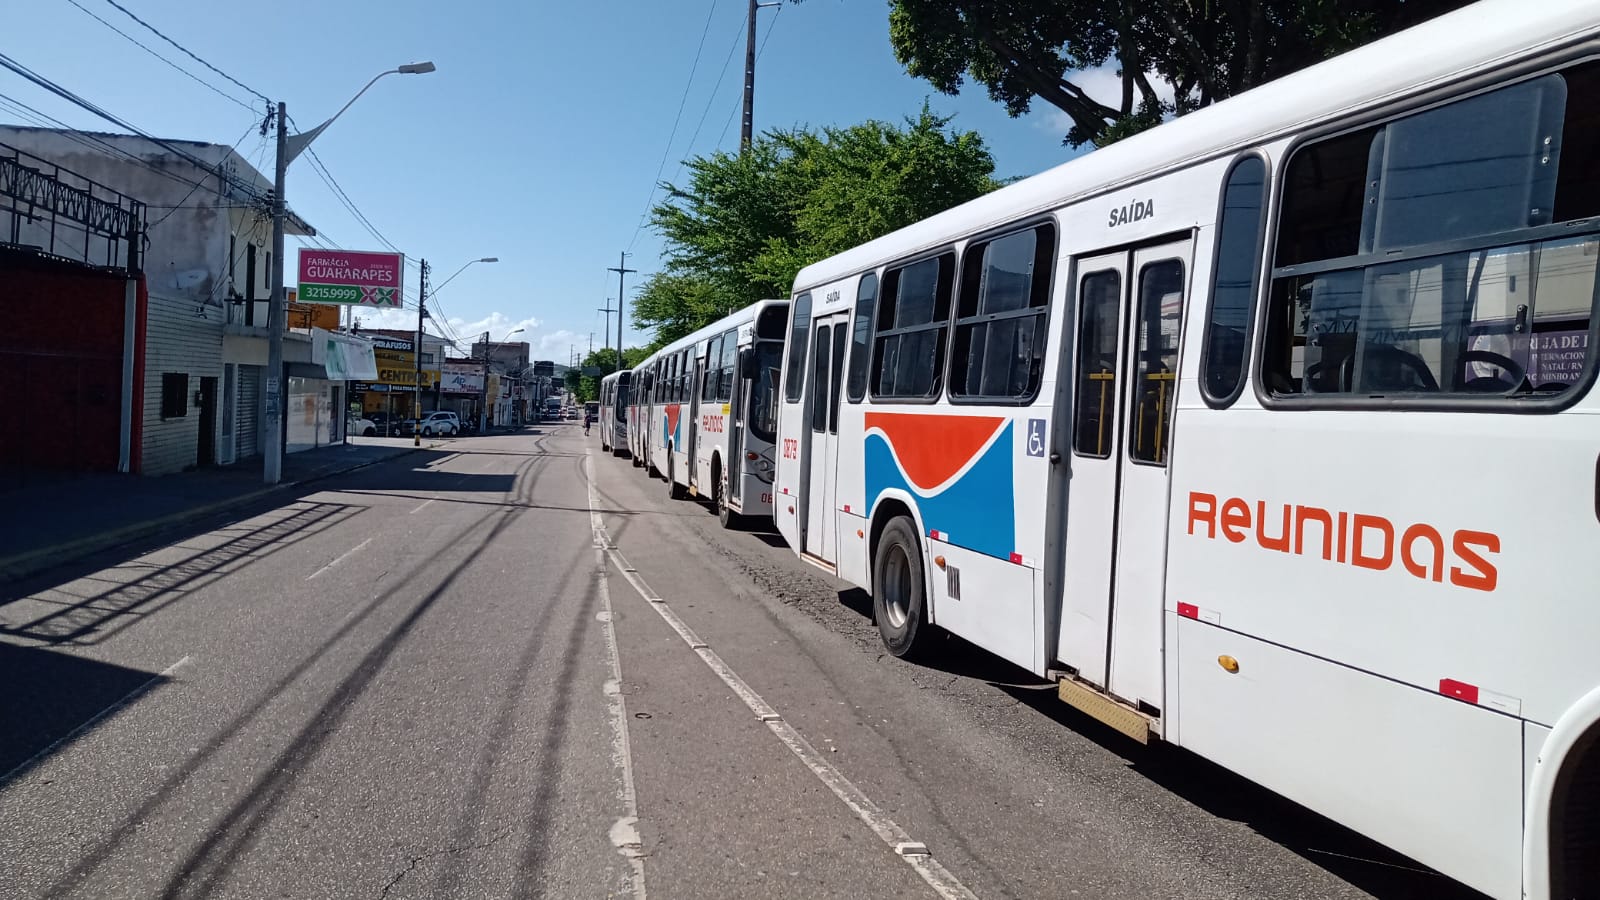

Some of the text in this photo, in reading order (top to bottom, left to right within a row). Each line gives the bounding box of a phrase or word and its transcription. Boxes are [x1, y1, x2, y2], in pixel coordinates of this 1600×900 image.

[1108, 199, 1154, 228] SAÍDA
[307, 258, 349, 267] FARMÁCIA
[307, 266, 393, 282] GUARARAPES
[306, 287, 357, 300] 3215.9999
[826, 289, 841, 304] SAÍDA
